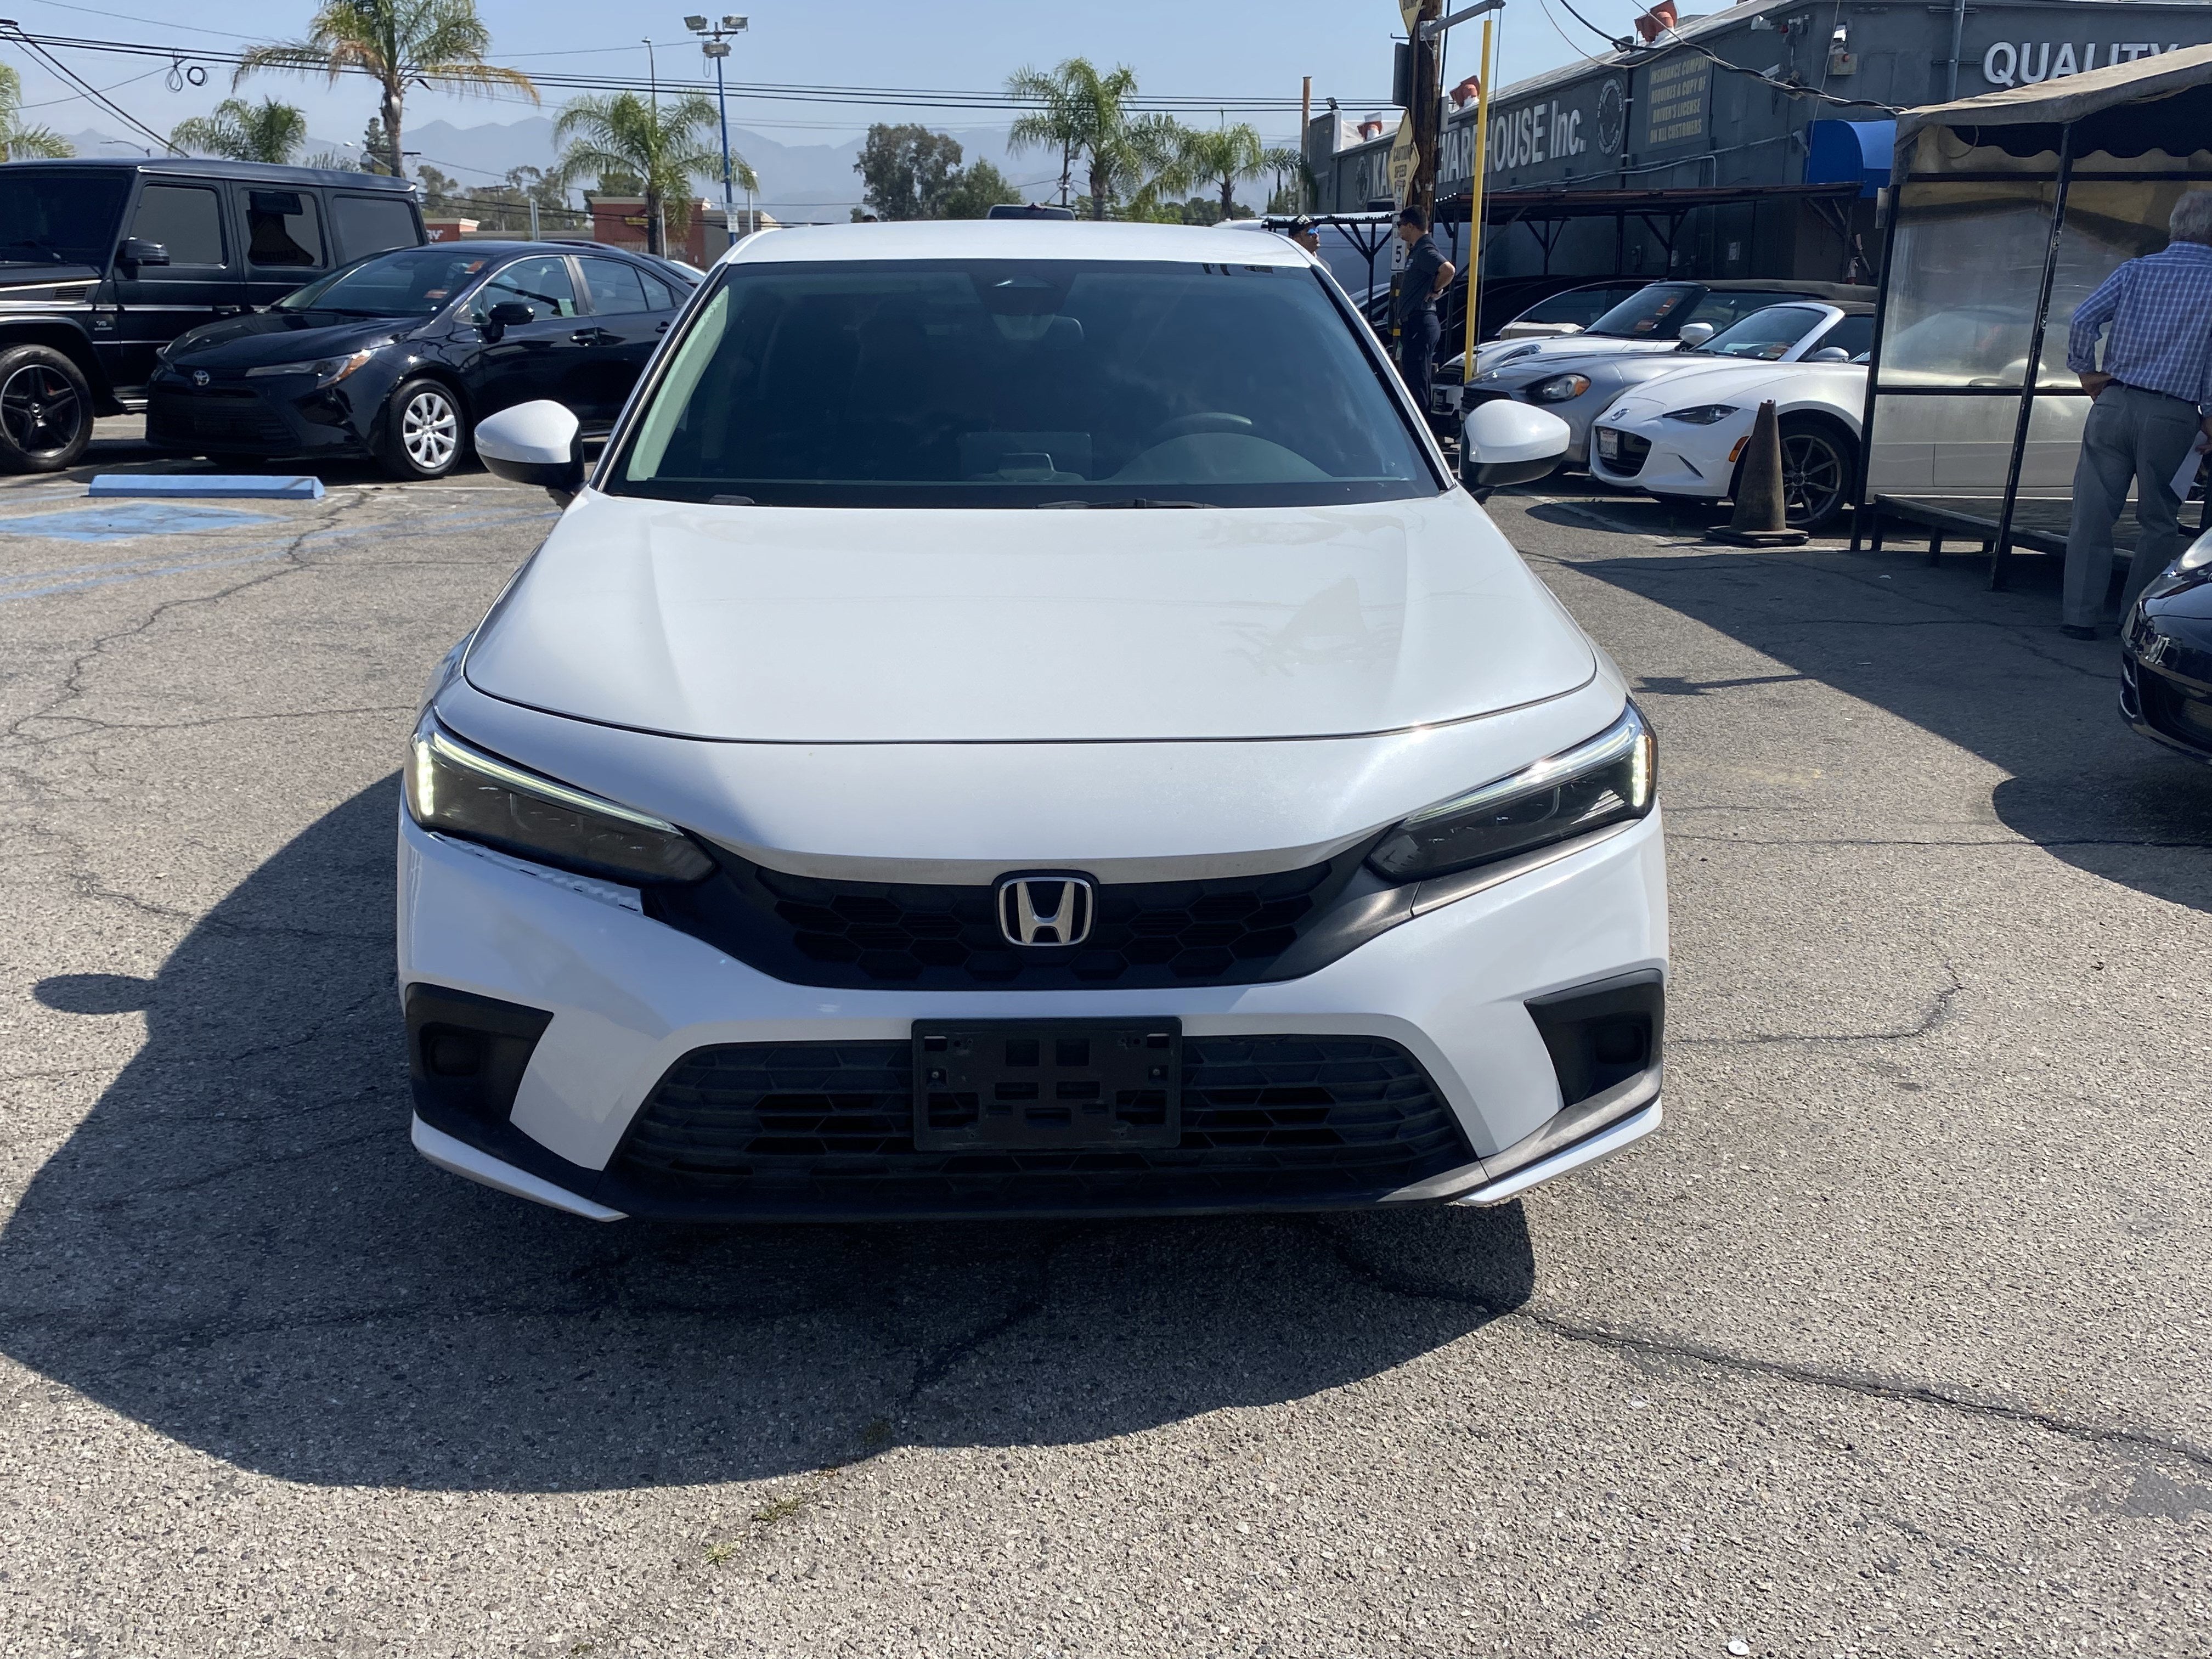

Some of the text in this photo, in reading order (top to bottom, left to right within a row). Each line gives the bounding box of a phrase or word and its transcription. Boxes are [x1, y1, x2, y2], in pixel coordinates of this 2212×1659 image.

[1651, 75, 1707, 105] REQUIRES A COPY OF
[1677, 98, 1701, 117] LICENSE
[1550, 100, 1587, 159] Inc.
[1668, 119, 1702, 140] CUSTOMERS
[1396, 245, 1402, 263] 5
